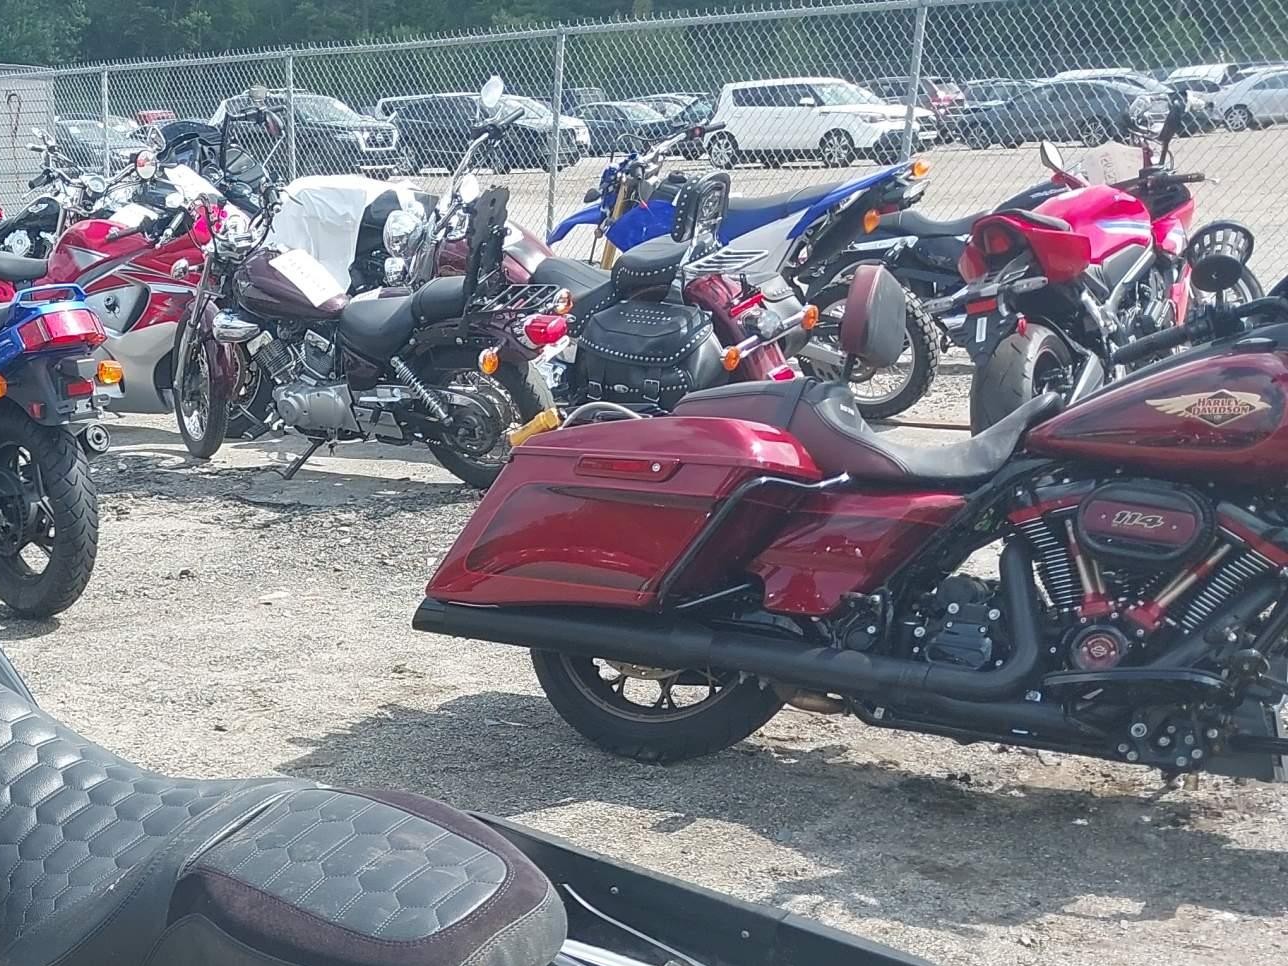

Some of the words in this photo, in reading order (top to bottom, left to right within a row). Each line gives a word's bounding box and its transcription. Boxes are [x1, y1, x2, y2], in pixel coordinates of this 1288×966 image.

[1197, 397, 1241, 408] HARLEY
[1192, 405, 1250, 416] DAVIDSON
[1112, 510, 1165, 529] 114
